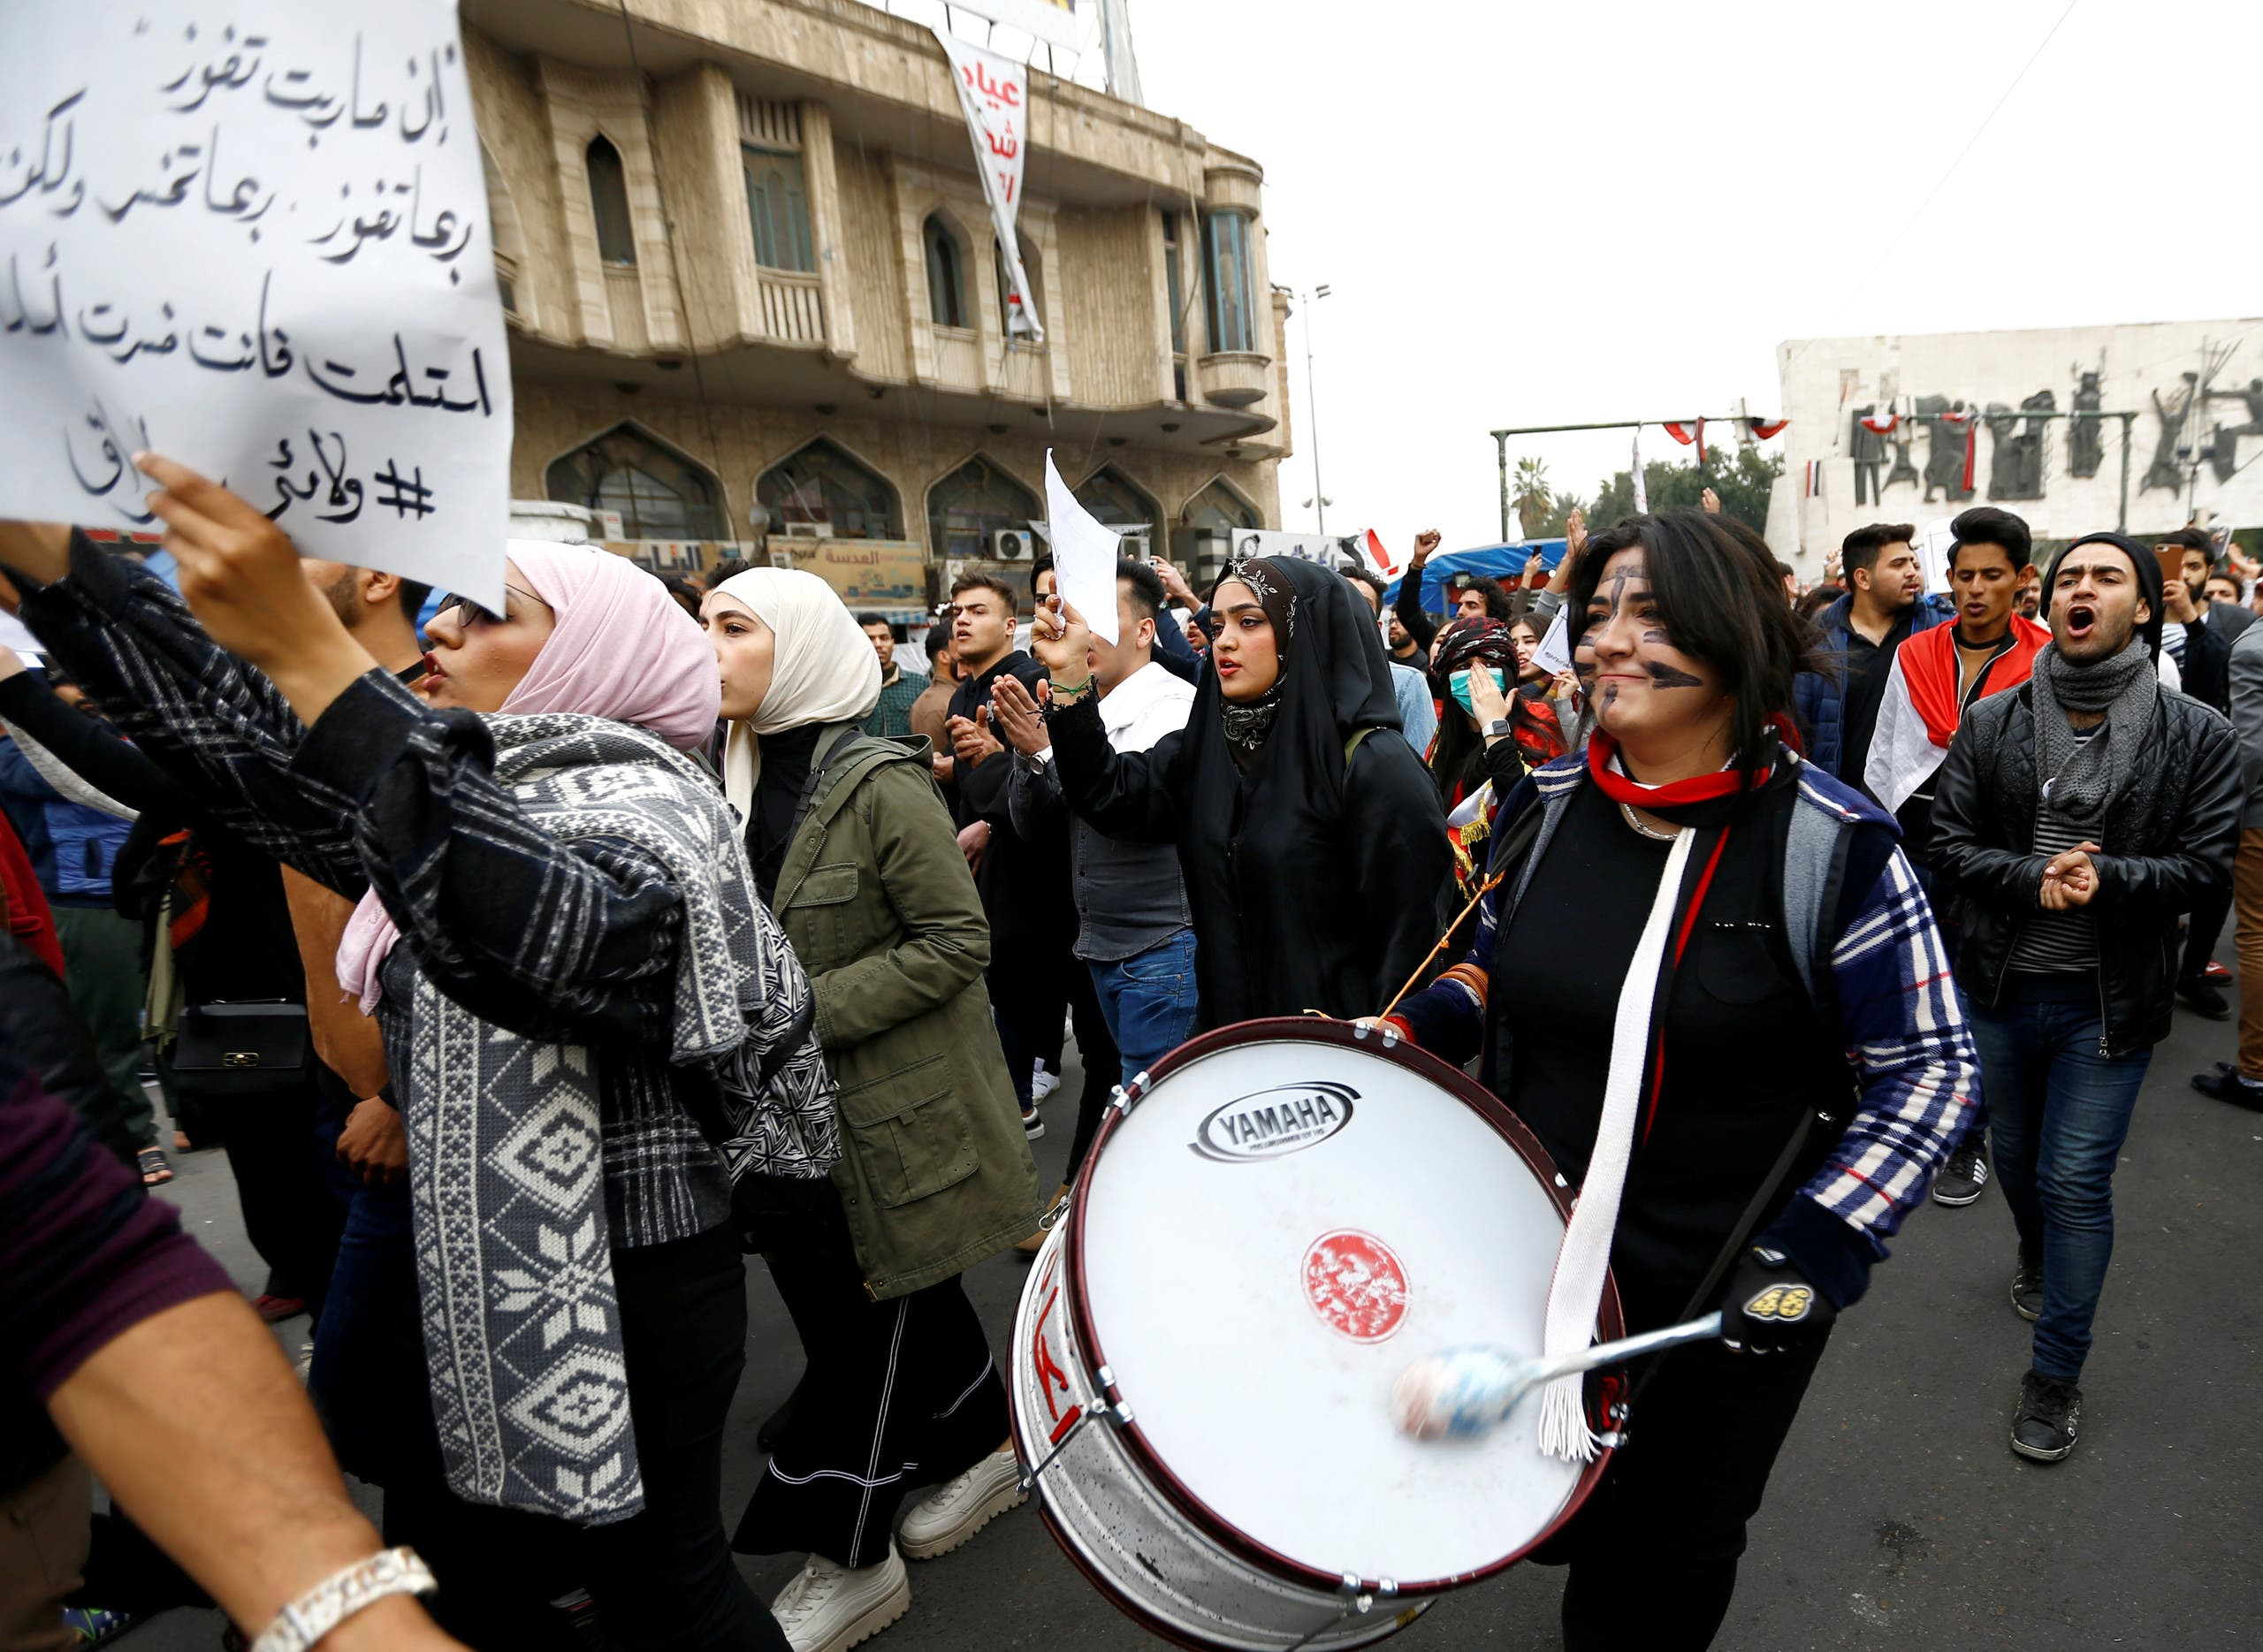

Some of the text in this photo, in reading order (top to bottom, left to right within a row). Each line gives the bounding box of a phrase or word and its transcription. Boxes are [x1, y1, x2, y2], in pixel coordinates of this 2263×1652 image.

[159, 21, 269, 115] تفوز
[92, 145, 202, 225] تخسر
[205, 123, 277, 244] ربما
[307, 179, 410, 265] تفوز
[411, 164, 472, 285] ربما
[825, 547, 880, 565] العدسة
[1217, 1094, 1338, 1146] YAMAHA
[1749, 1288, 1810, 1318] 46
